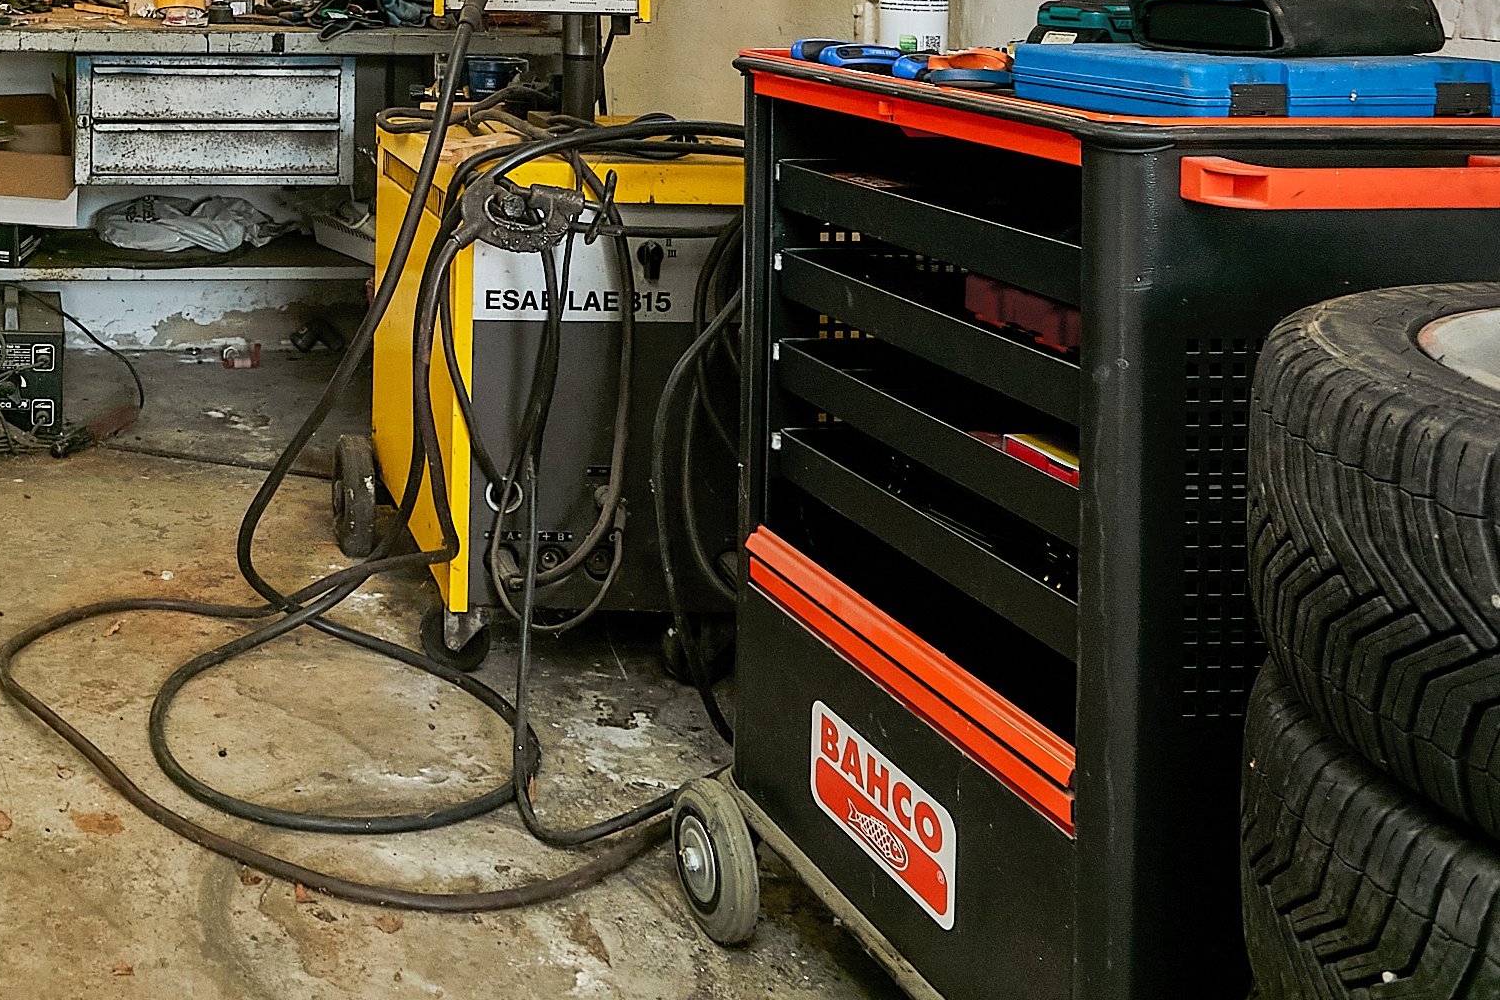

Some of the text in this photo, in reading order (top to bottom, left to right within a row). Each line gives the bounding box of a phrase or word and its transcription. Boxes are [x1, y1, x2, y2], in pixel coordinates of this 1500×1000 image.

[568, 290, 619, 312] LAE
[506, 532, 514, 540] A
[558, 533, 565, 541] B
[820, 712, 943, 854] BAHCO
